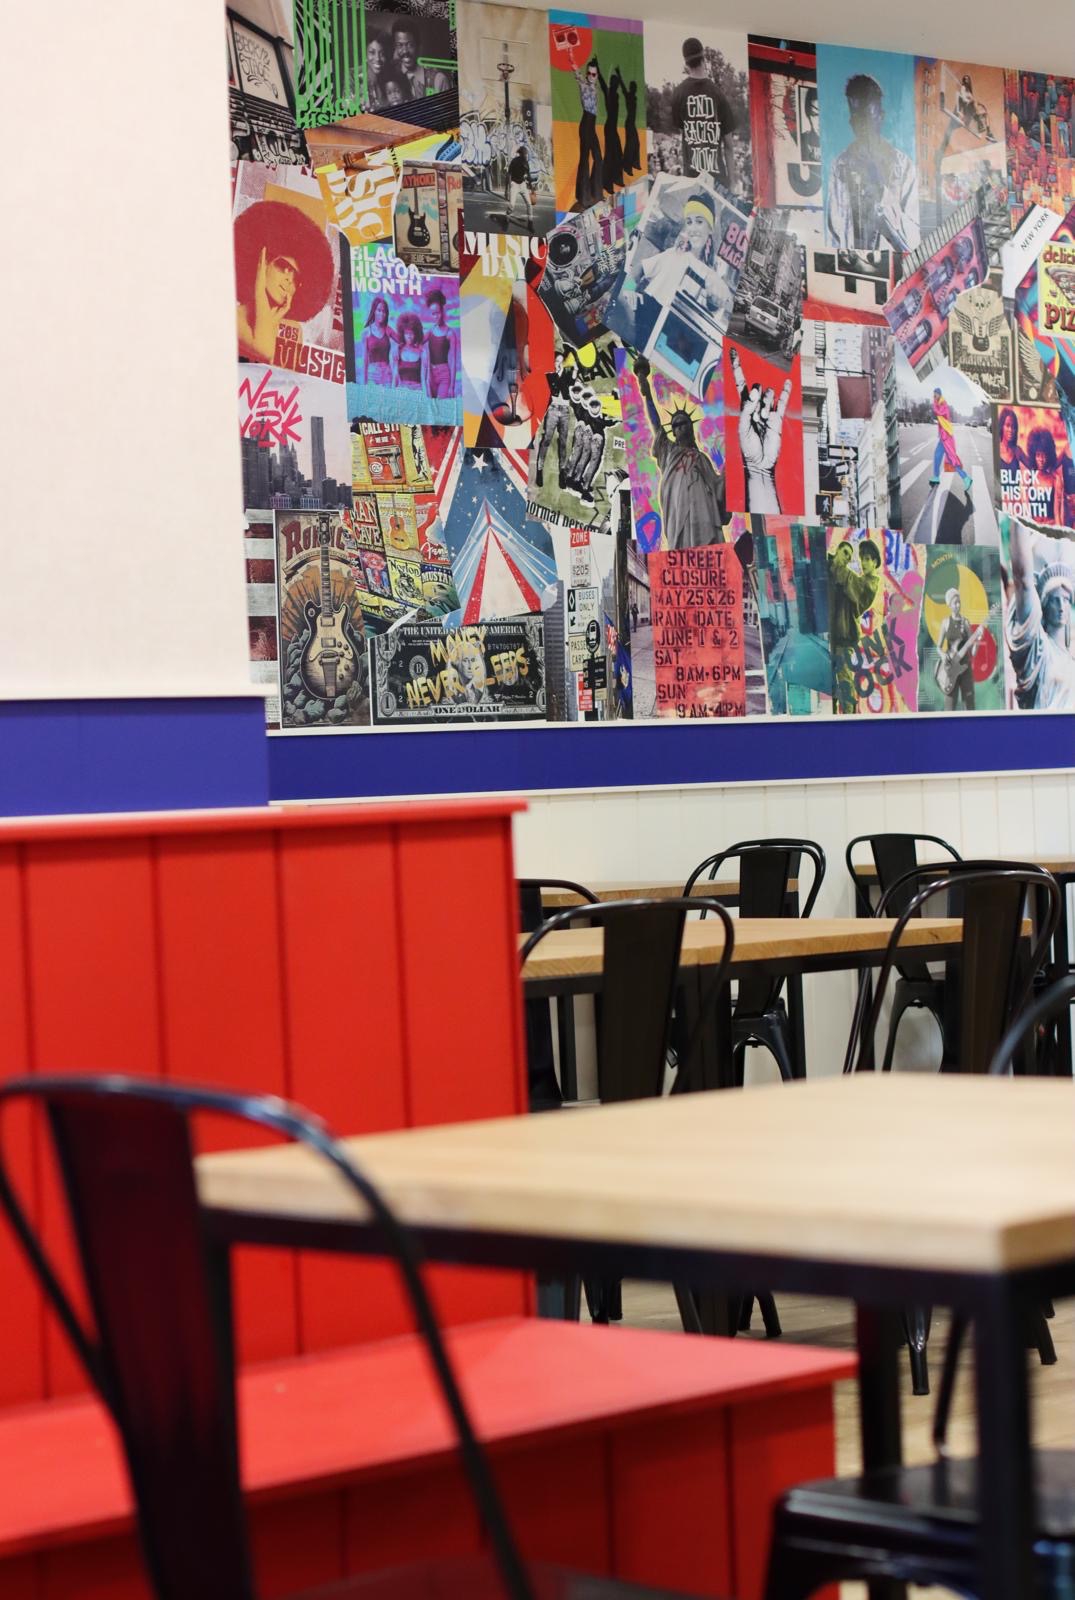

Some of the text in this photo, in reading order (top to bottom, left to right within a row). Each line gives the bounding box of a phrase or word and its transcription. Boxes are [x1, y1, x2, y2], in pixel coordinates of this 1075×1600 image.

[1020, 210, 1050, 251] NEW YORK
[463, 231, 547, 260] MUSIC
[350, 246, 397, 263] BLAC
[351, 257, 431, 281] HISTOR
[481, 254, 532, 281] DAY
[352, 278, 422, 296] MONTH
[239, 369, 300, 414] NEW
[361, 422, 383, 436] CALL
[1000, 469, 1040, 485] BLACK
[1001, 485, 1053, 502] HISTORY
[1002, 502, 1048, 518] MONTH
[353, 522, 383, 548] CAVE
[571, 531, 588, 544] ZONE
[387, 557, 421, 578] Norton
[667, 550, 724, 568] STREET
[662, 569, 727, 587] CLOSURE
[578, 590, 595, 601] BUSES
[655, 589, 736, 606] MAY 25 & 26
[579, 602, 595, 612] ONLY
[655, 610, 687, 627] RAIN
[403, 626, 420, 636] THE
[420, 626, 449, 636] UNITED
[490, 625, 524, 635] AMERICA
[657, 628, 693, 646] JUNE
[712, 628, 722, 646] &
[729, 630, 738, 646] 2
[571, 640, 586, 651] PASSE
[655, 649, 681, 666] SAT
[657, 684, 687, 700] SUN
[434, 704, 501, 714] ONE DOLLAR
